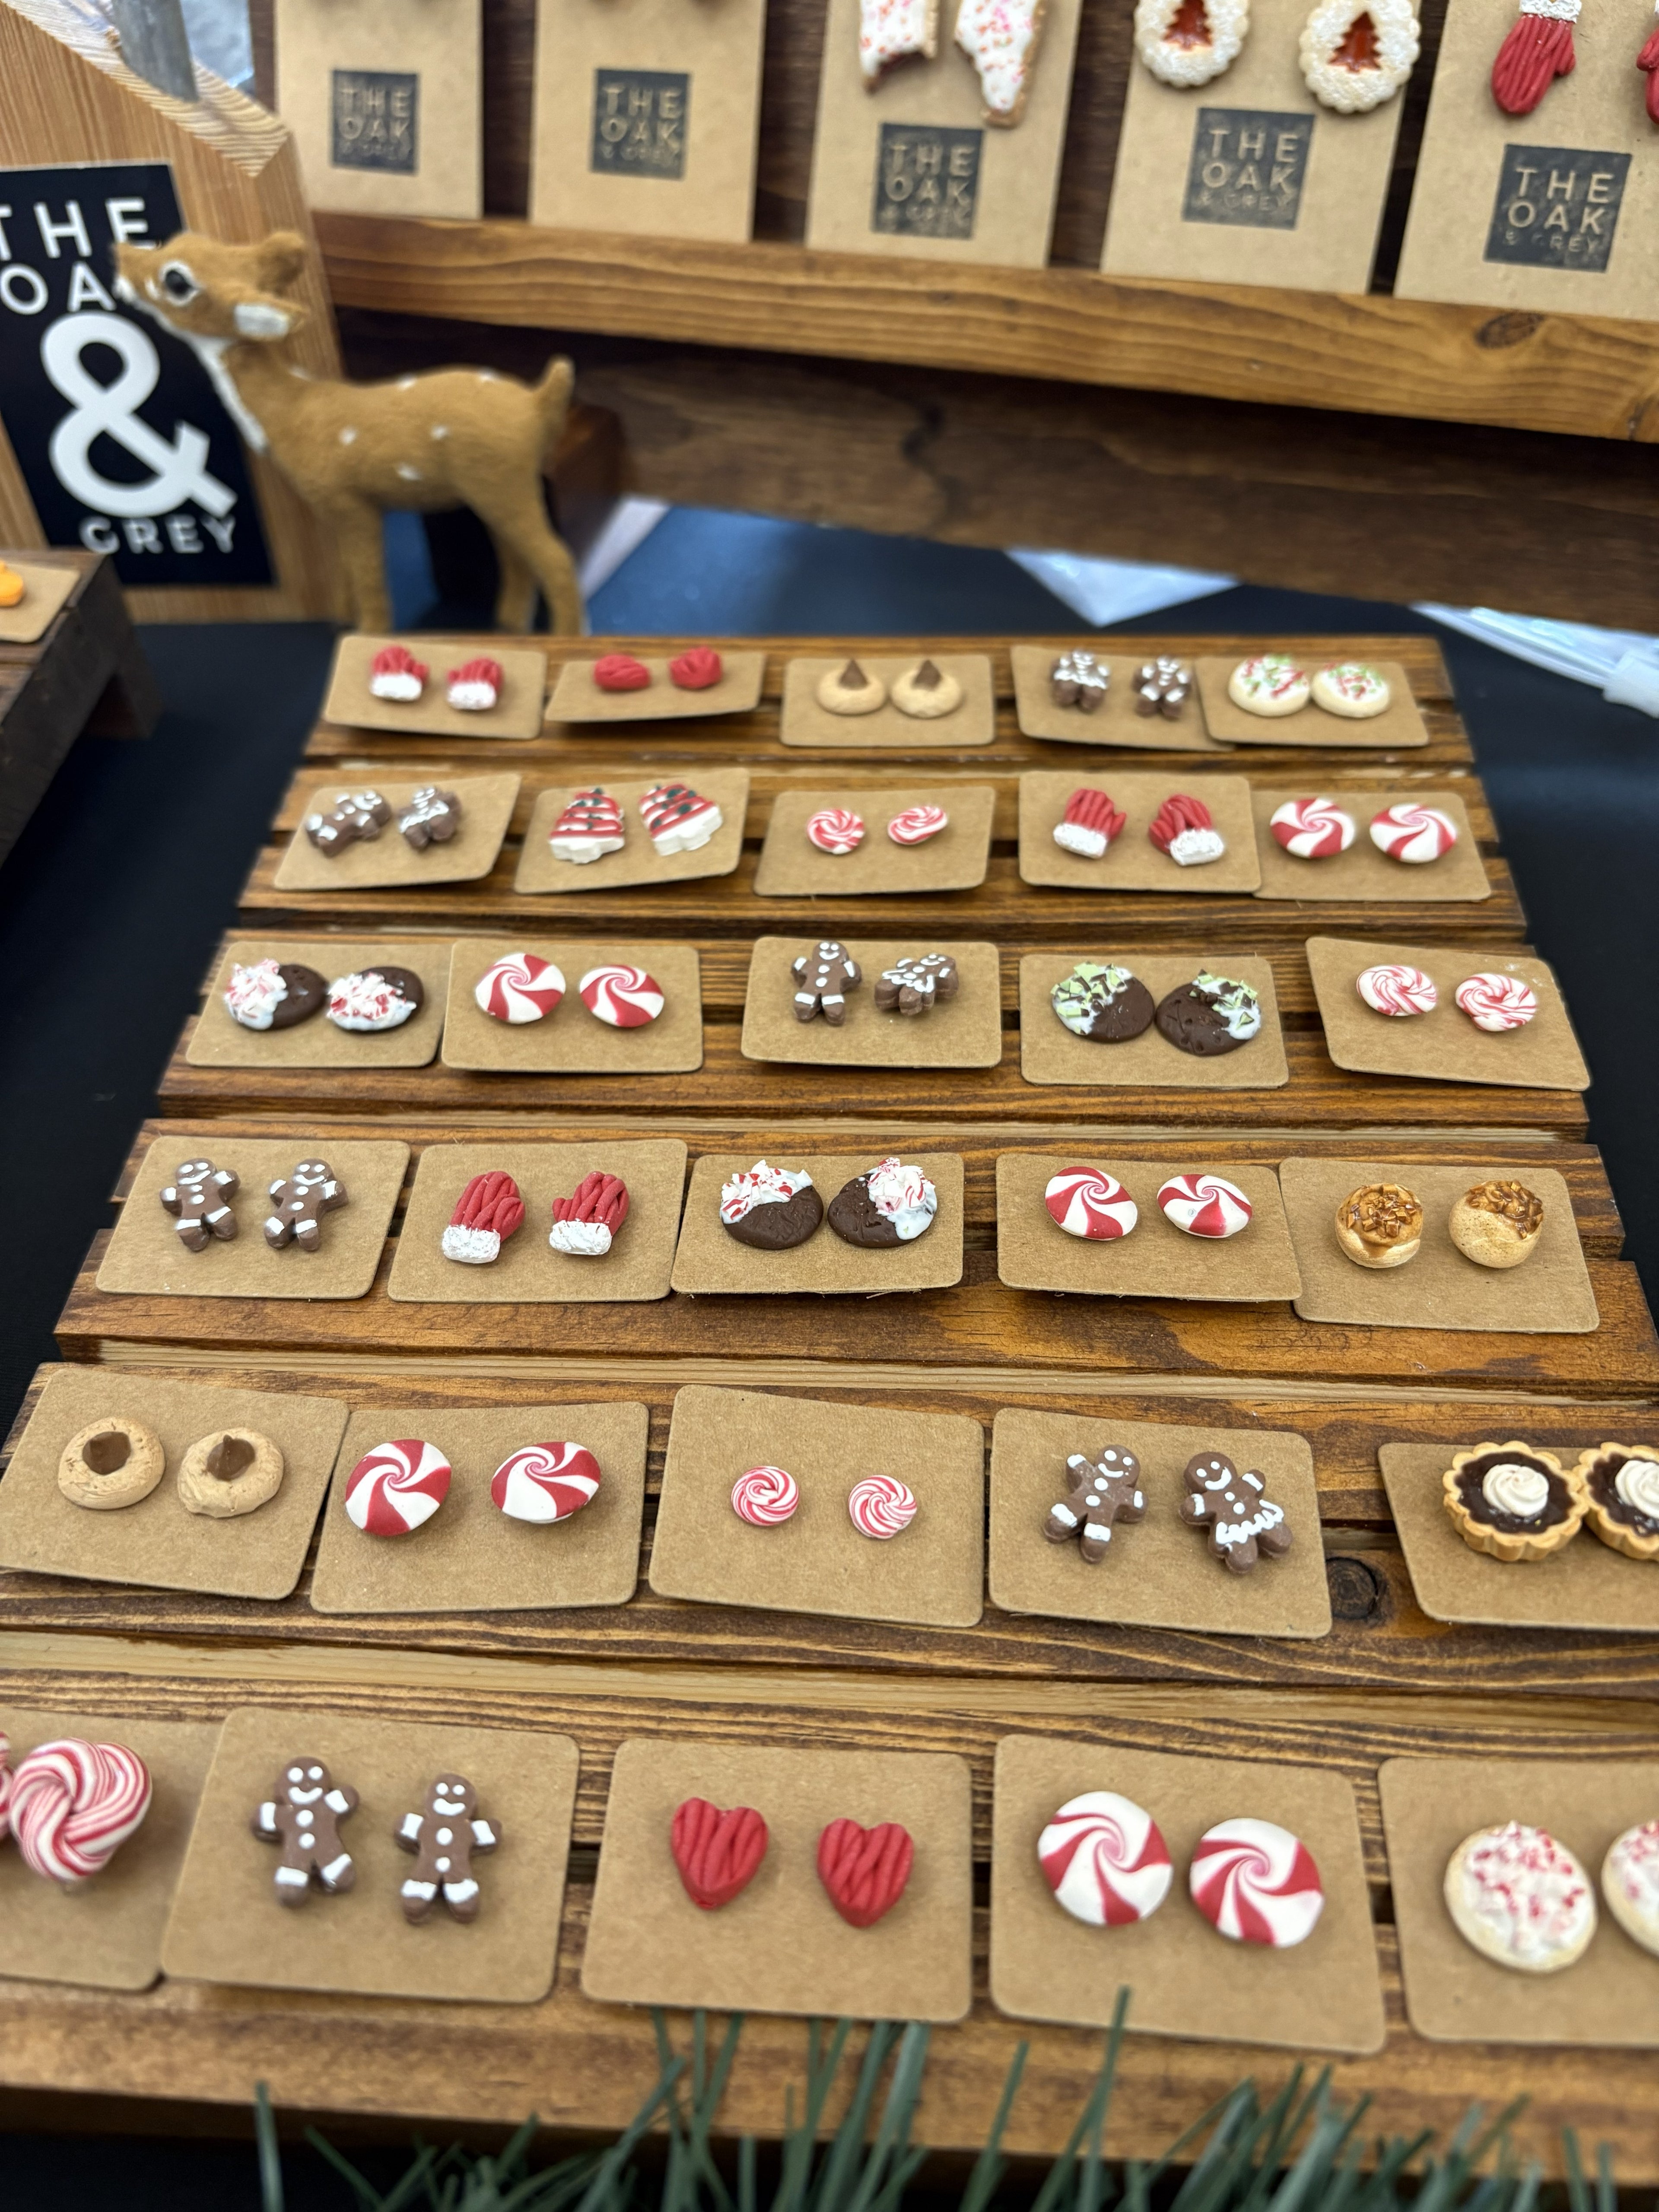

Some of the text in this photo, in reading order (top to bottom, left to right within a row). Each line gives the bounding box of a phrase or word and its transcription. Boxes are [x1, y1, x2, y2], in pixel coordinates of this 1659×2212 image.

[340, 88, 410, 117] THE
[602, 84, 682, 119] THE
[339, 117, 410, 144] OAK
[601, 117, 680, 148] OAK
[1209, 129, 1298, 163] THE
[889, 144, 974, 176] THE
[886, 176, 971, 207] OAK
[1201, 162, 1296, 194] OAK
[1516, 168, 1615, 203] THE
[1508, 201, 1605, 235] OAK
[0, 262, 118, 316] OA
[40, 310, 238, 518] &
[79, 515, 237, 555] GREY
